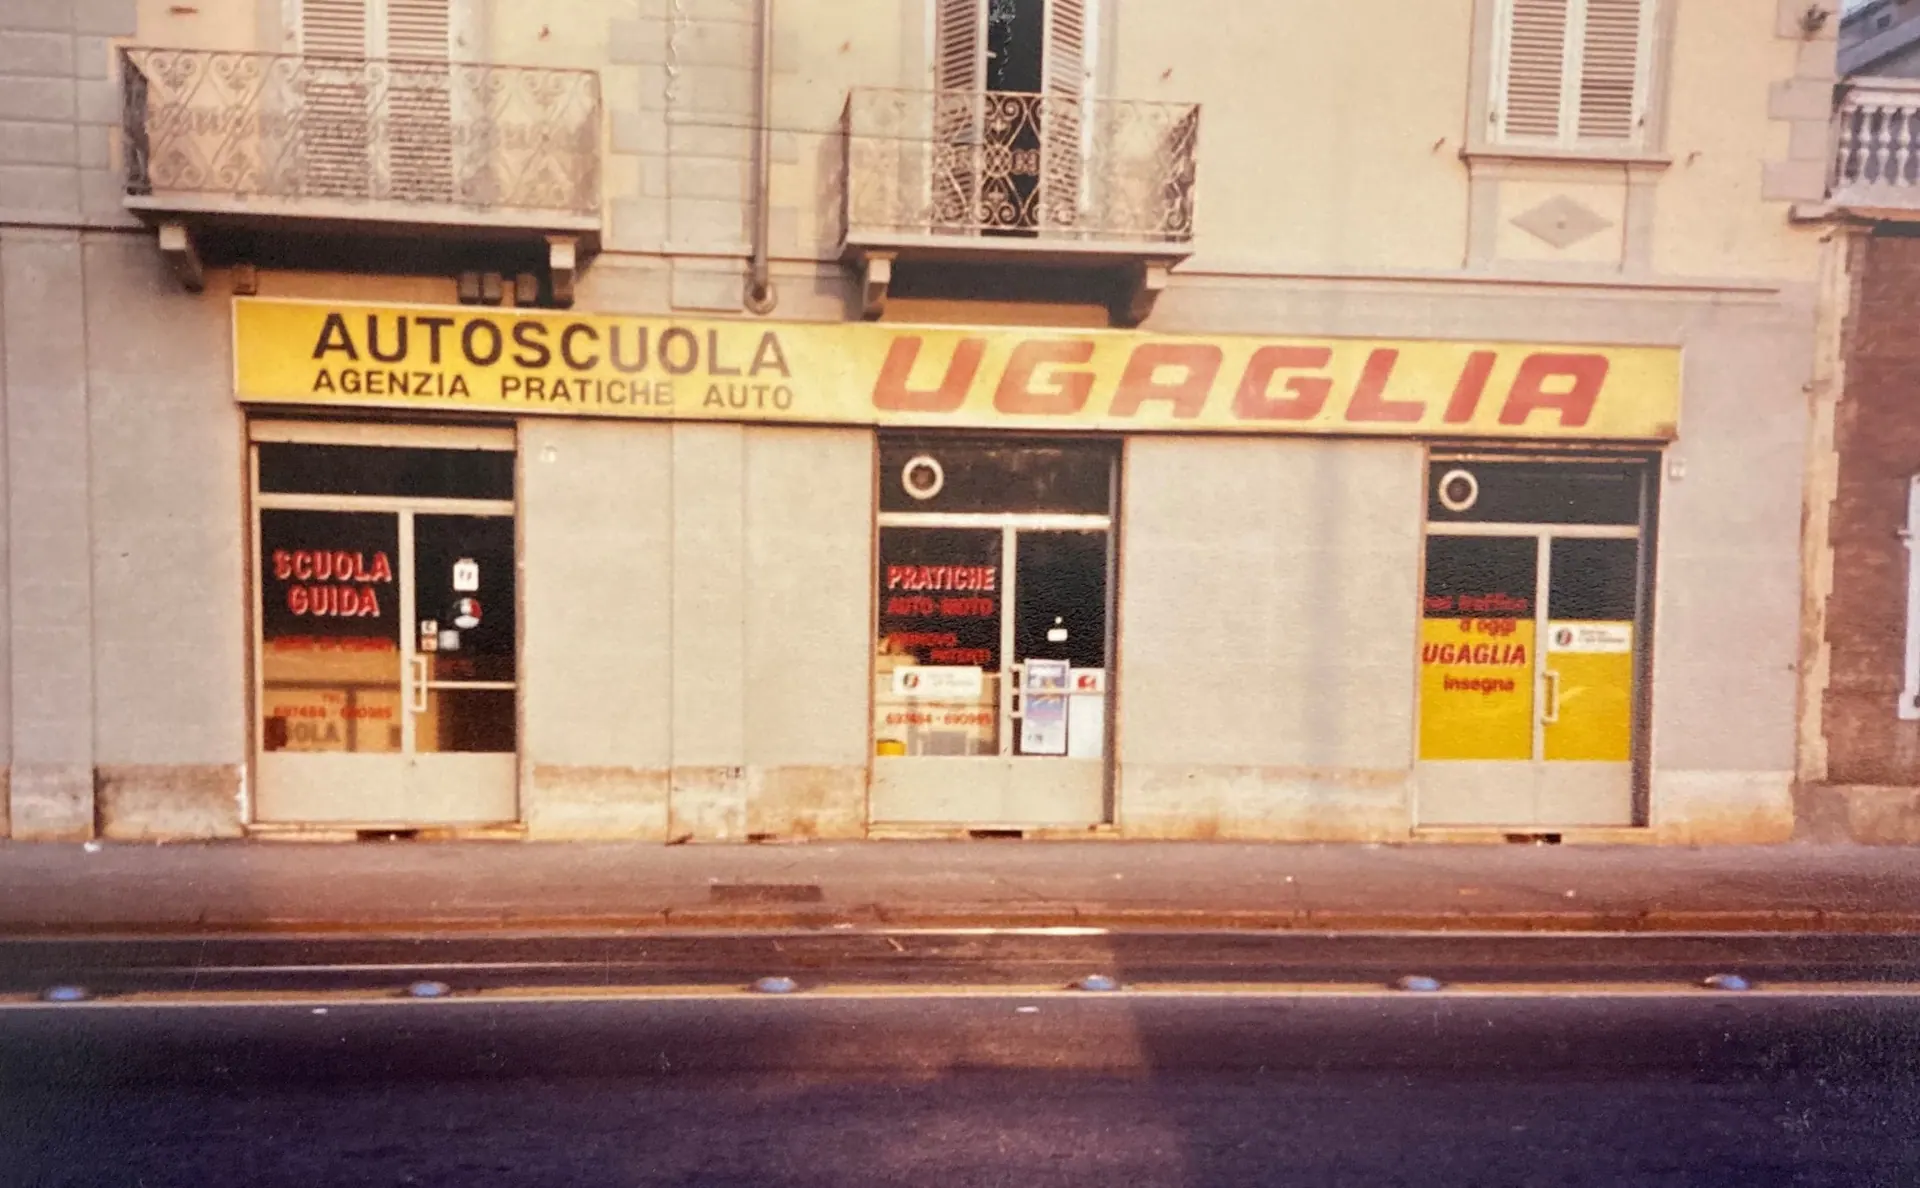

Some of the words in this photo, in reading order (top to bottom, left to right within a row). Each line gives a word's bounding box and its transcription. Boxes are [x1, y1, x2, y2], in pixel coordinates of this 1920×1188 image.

[312, 313, 792, 377] AUTOSCUOLA
[872, 335, 1609, 427] UGAGLIA
[313, 368, 470, 399] AGENZIA
[501, 376, 675, 406] PRATICHE
[703, 384, 794, 410] AUTO
[274, 551, 392, 582] SCUOLA
[887, 565, 996, 590] PRATICHE
[288, 585, 380, 616] GUIDA
[1423, 643, 1526, 665] UGAGLIA
[1443, 675, 1515, 695] insegna
